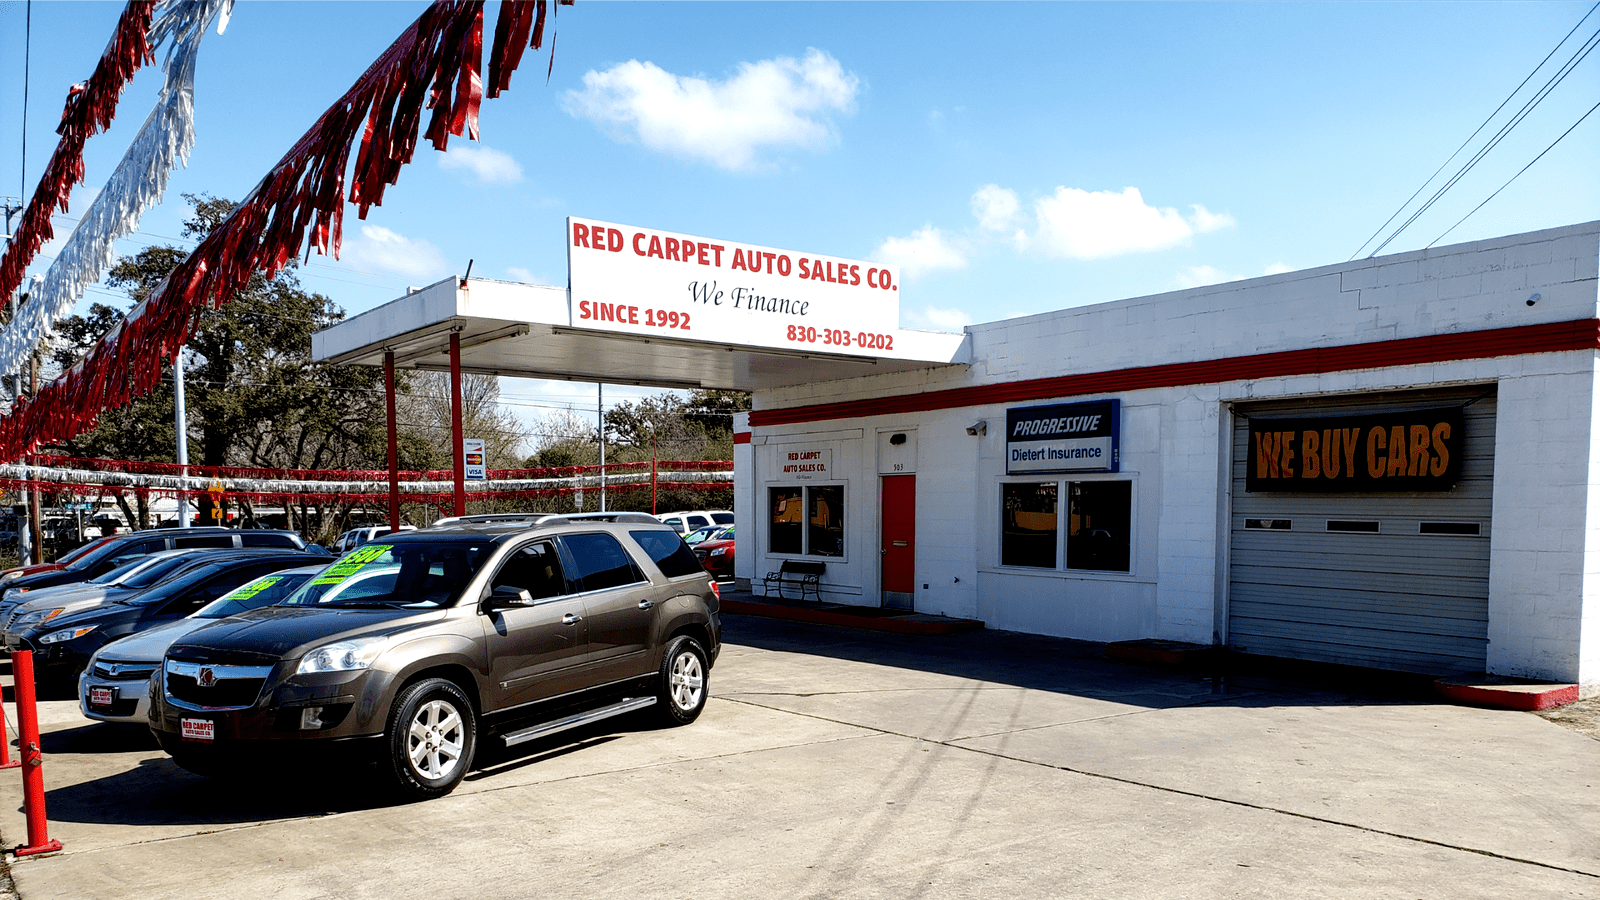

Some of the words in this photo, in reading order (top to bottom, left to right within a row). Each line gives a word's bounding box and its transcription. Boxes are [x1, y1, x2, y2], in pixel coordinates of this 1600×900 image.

[573, 222, 624, 253] RED
[632, 232, 725, 267] CARPET
[731, 248, 792, 277] AUTO
[799, 257, 861, 287] SALES
[867, 267, 898, 291] CO.
[687, 280, 724, 306] We
[731, 286, 809, 316] Finance
[579, 300, 639, 325] SINCE
[645, 308, 691, 330] 1992
[786, 324, 894, 350] 830-303-0202
[1013, 415, 1101, 436] PROGRESSIVE
[800, 451, 821, 460] CARPET
[1012, 448, 1045, 461] Dietert
[1048, 447, 1101, 460] Insurance
[1255, 431, 1295, 479] WE
[1302, 428, 1360, 479] BUY
[1367, 422, 1451, 478] CARS
[783, 465, 797, 473] AUTO
[799, 464, 815, 472] SALES
[817, 463, 827, 471] CO.
[893, 463, 903, 471] 503
[182, 721, 192, 729] RED
[193, 722, 213, 731] CARPET
